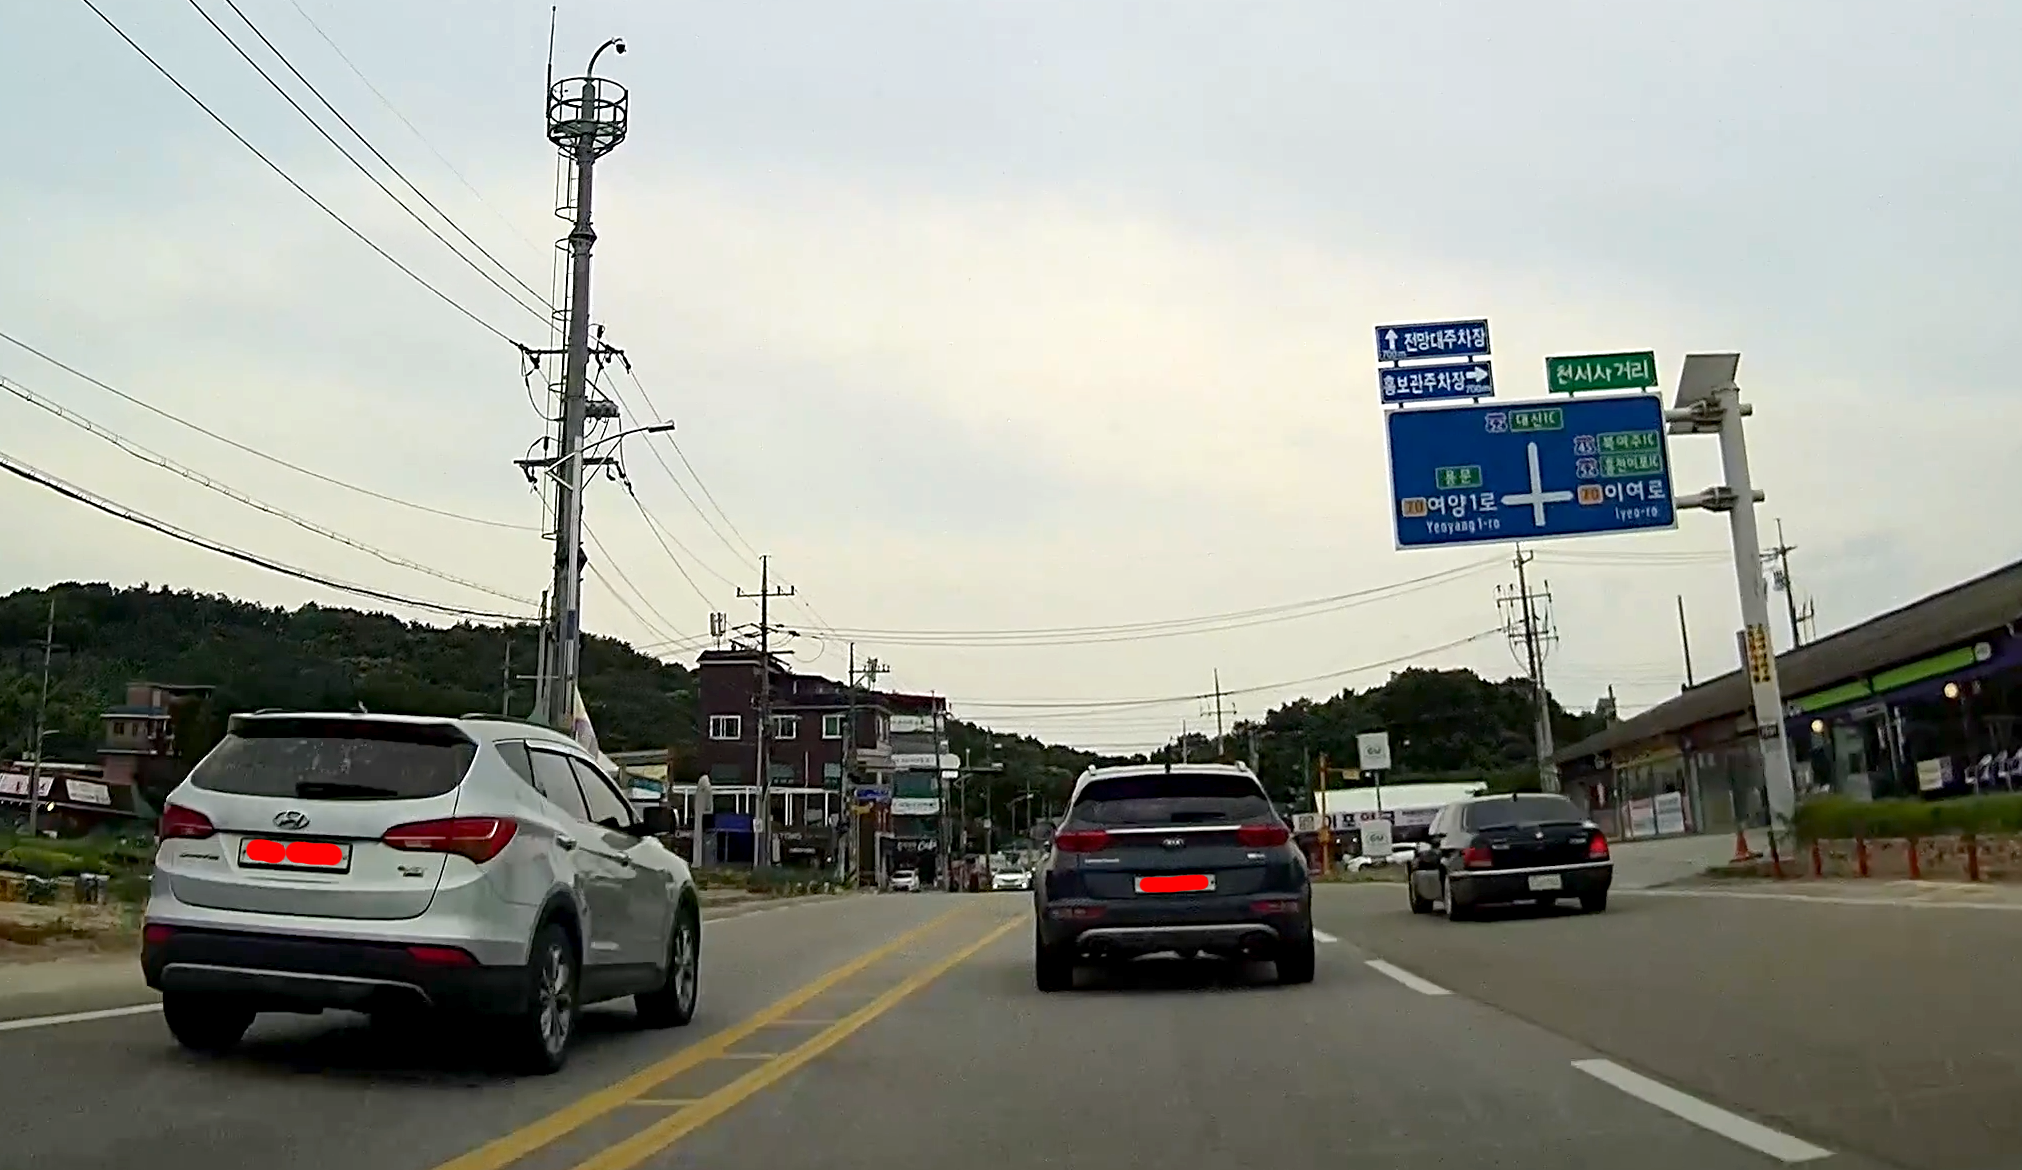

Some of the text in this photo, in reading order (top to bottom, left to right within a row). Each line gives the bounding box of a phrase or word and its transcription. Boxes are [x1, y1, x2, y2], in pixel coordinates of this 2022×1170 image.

[1404, 327, 1485, 352] 전망대주차장
[1383, 370, 1465, 396] 홍보관주차장
[1604, 479, 1666, 502] 이여로
[1427, 492, 1498, 518] 여양1로
[1614, 506, 1658, 522] Iyeo-ro
[1426, 520, 1476, 535] Yeoyang
